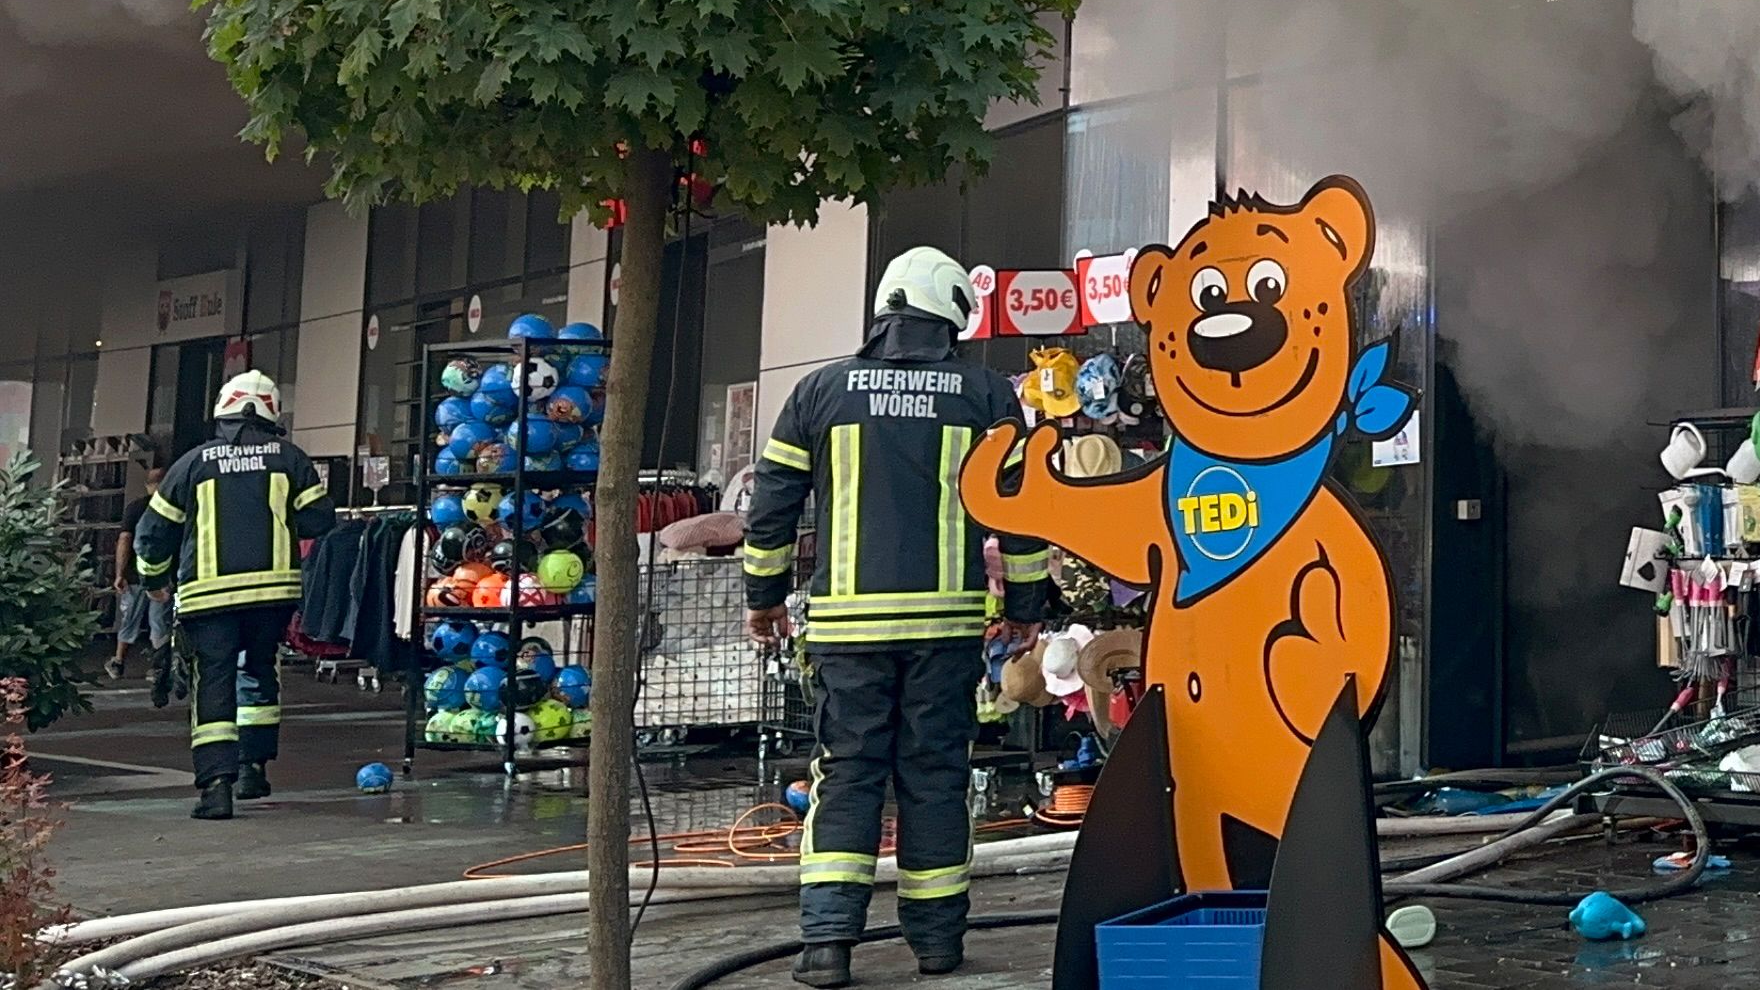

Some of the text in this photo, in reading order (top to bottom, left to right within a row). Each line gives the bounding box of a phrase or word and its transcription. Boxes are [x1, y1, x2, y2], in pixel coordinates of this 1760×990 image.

[972, 271, 992, 291] AB
[1010, 288, 1074, 316] 3,50€
[847, 369, 963, 395] FEUERWEHR
[869, 390, 938, 418] WÖRGL
[202, 442, 281, 463] FEUERWEHR
[1177, 490, 1259, 535] TEDi
